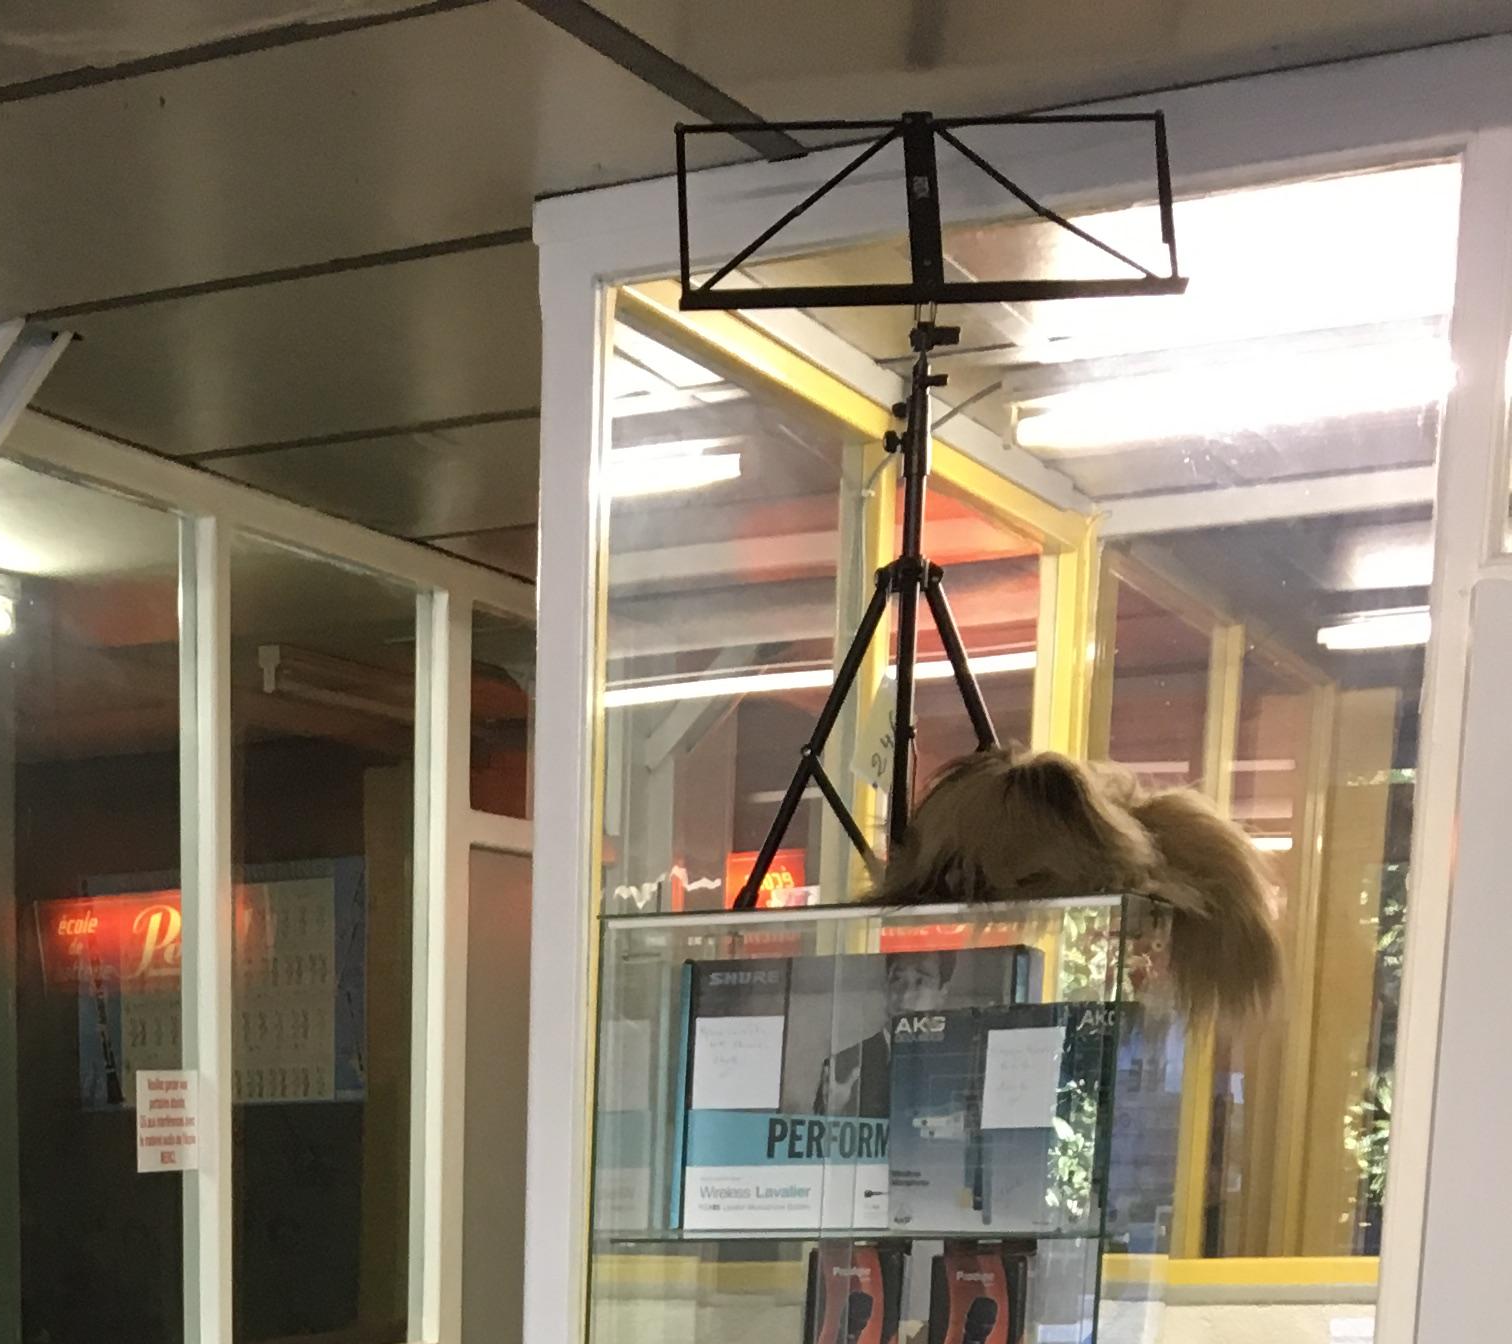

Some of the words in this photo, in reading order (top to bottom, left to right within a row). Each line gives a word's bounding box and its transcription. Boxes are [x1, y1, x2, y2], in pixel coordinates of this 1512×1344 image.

[58, 910, 99, 936] école
[708, 970, 780, 987] SHURE
[699, 1186, 751, 1200] Wireless
[755, 1184, 812, 1199] Lavalier
